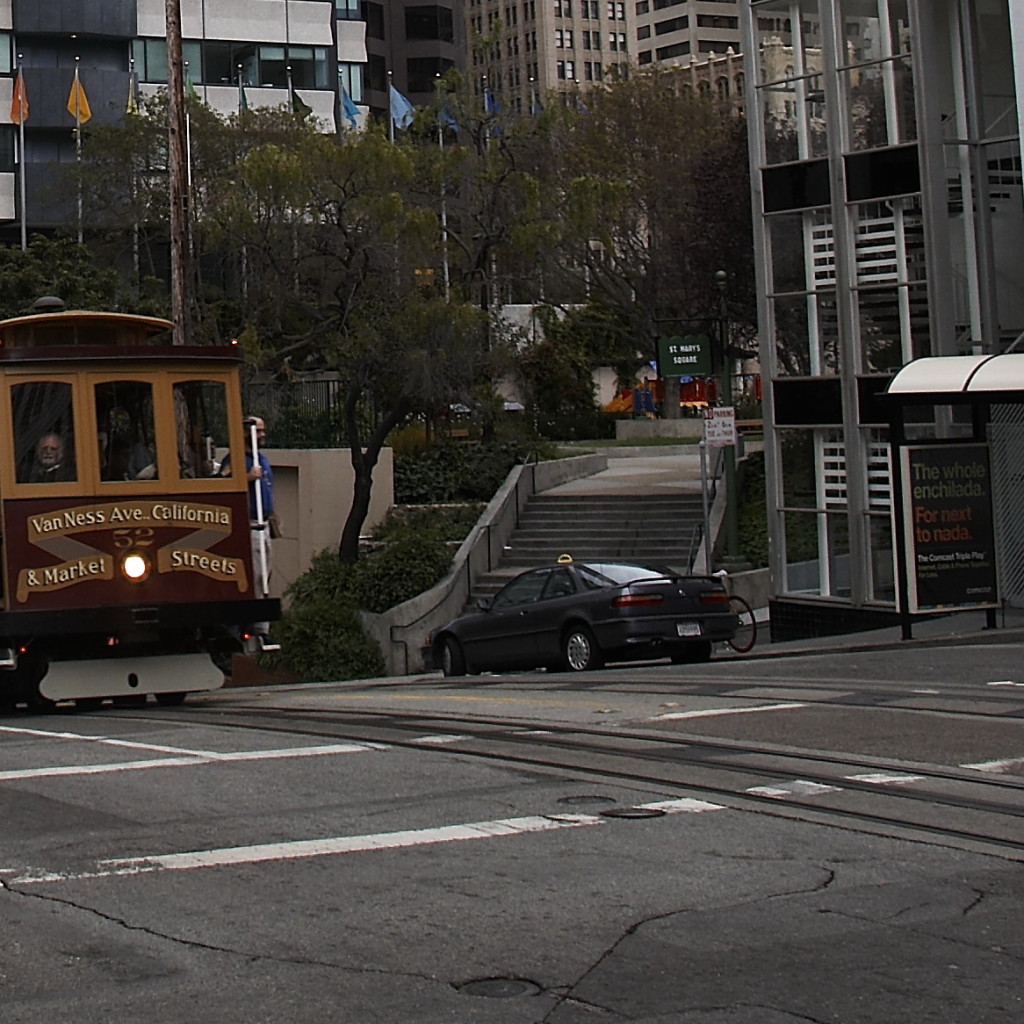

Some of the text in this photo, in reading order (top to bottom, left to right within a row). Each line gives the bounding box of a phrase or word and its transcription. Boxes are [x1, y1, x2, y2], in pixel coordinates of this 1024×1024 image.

[673, 355, 698, 364] SQUARE
[912, 461, 986, 481] The whole
[913, 480, 986, 499] enchilada.
[32, 515, 63, 534] Van
[64, 508, 106, 527] Ness
[152, 504, 229, 525] California
[915, 506, 973, 523] For next
[113, 527, 155, 549] 52
[916, 525, 973, 543] to nada.
[171, 550, 237, 575] Streets
[917, 551, 985, 563] The Comcast Triple Play
[27, 558, 106, 586] & Market
